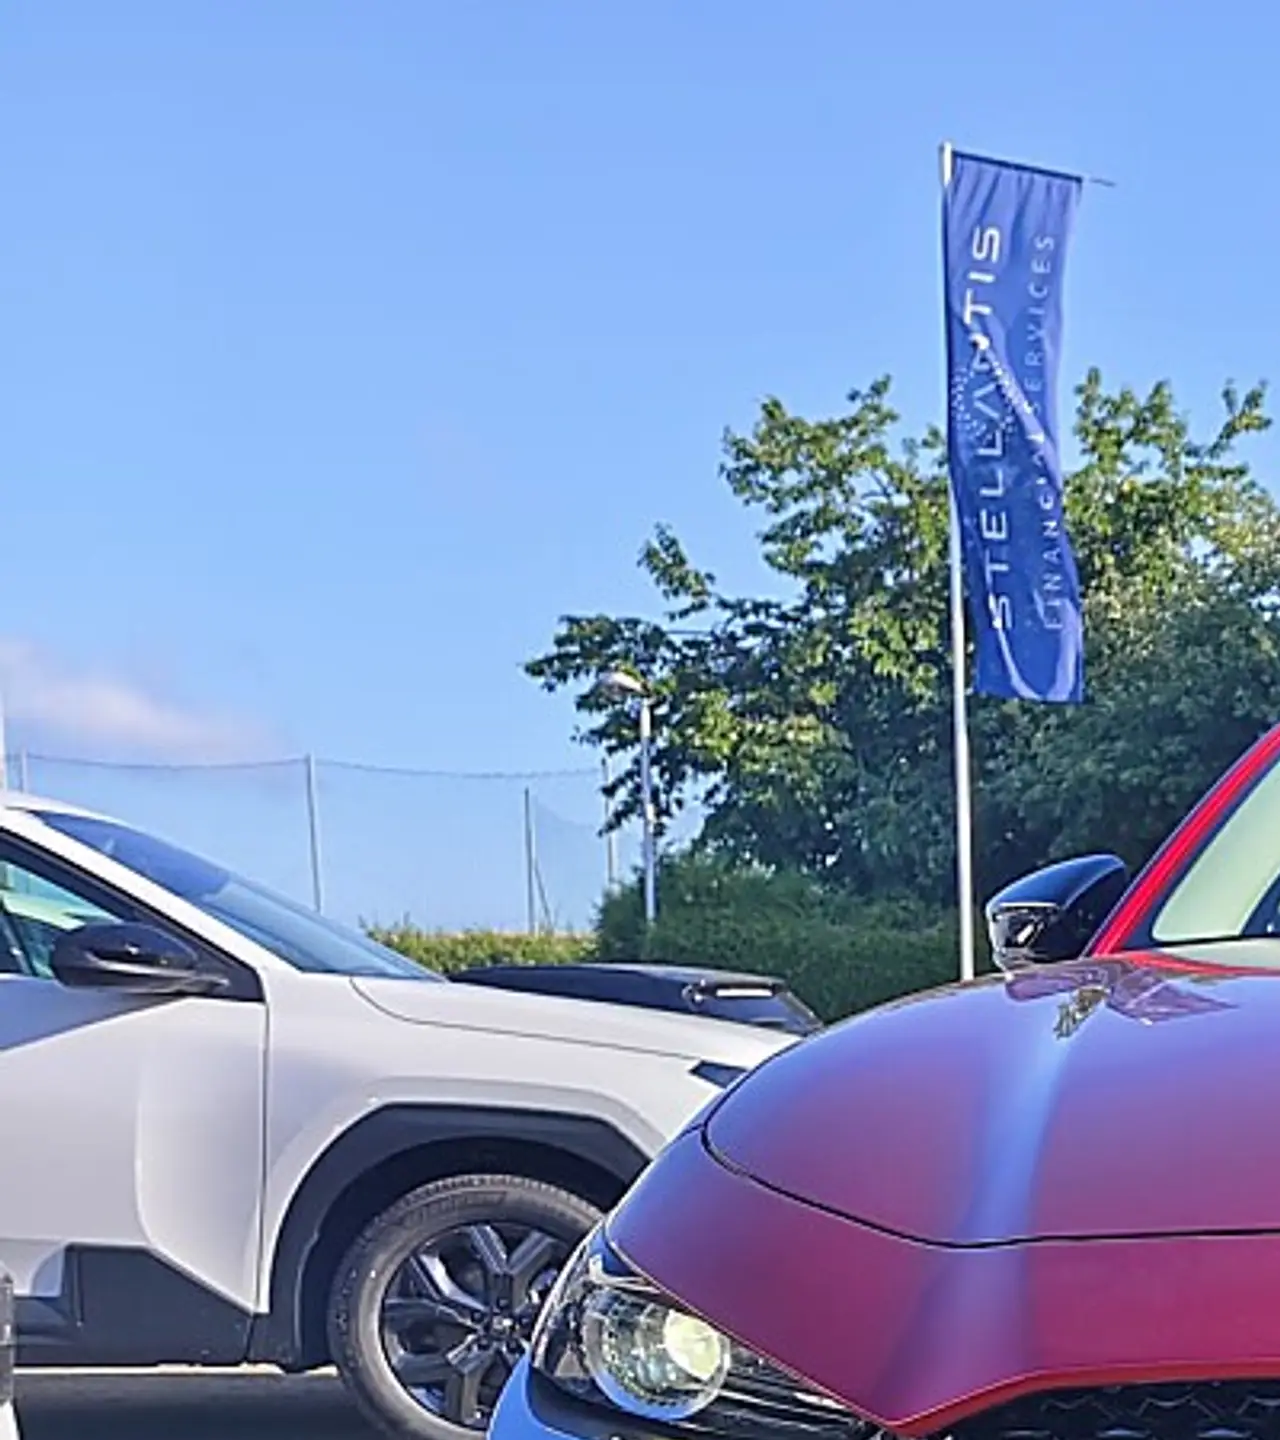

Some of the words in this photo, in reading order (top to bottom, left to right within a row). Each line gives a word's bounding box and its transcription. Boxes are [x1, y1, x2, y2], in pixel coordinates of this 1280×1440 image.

[1023, 234, 1055, 415] SERVICES
[962, 223, 1010, 631] STELLANTIS
[1035, 431, 1064, 632] FINANCIAL
